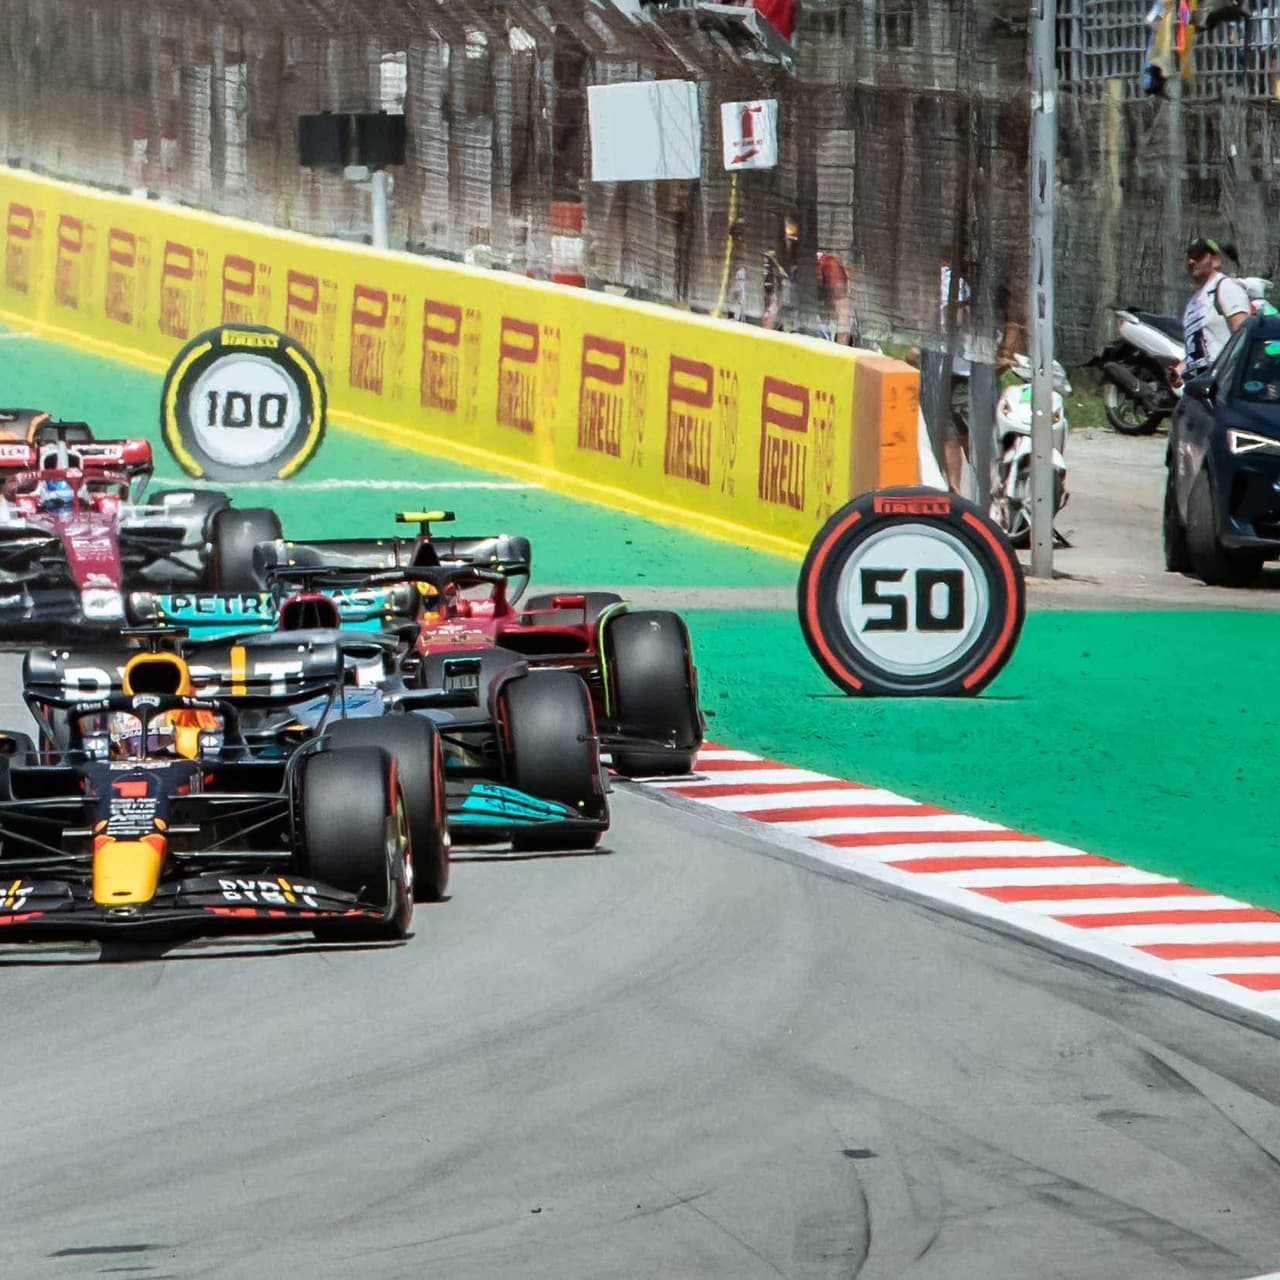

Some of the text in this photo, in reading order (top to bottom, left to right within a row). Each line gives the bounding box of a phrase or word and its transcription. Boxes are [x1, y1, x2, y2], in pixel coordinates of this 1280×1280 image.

[206, 391, 287, 428] 100
[664, 354, 714, 486] PIRELLI
[759, 375, 810, 512] PIRELLI
[873, 496, 951, 515] PIRELLI
[860, 568, 964, 632] 50
